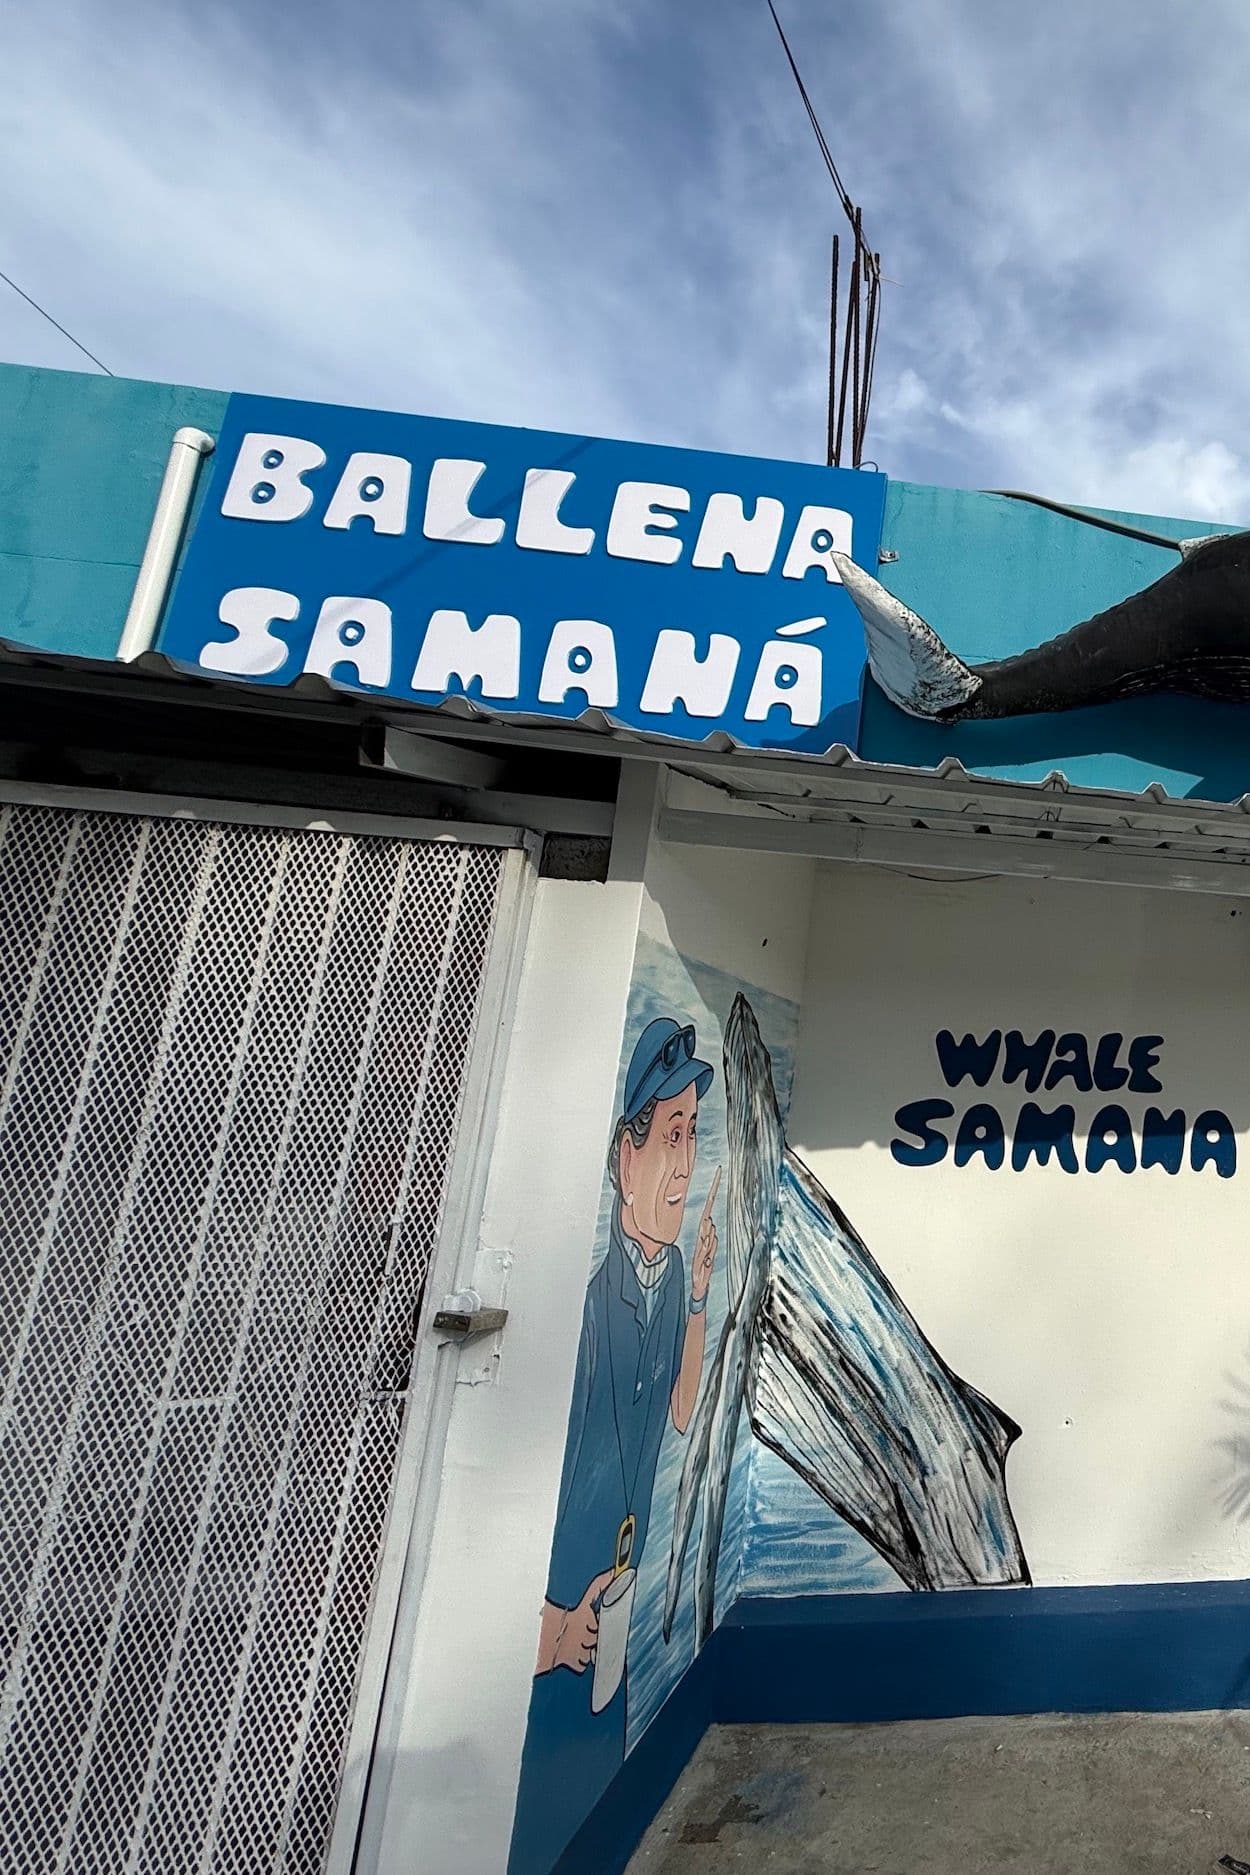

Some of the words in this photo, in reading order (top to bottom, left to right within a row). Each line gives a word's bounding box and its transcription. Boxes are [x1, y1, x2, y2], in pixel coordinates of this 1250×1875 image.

[220, 432, 853, 584] BALLENA
[199, 587, 827, 726] SAMANÁ
[936, 1029, 1164, 1093] WHALE
[890, 1099, 1236, 1178] SAMANA
